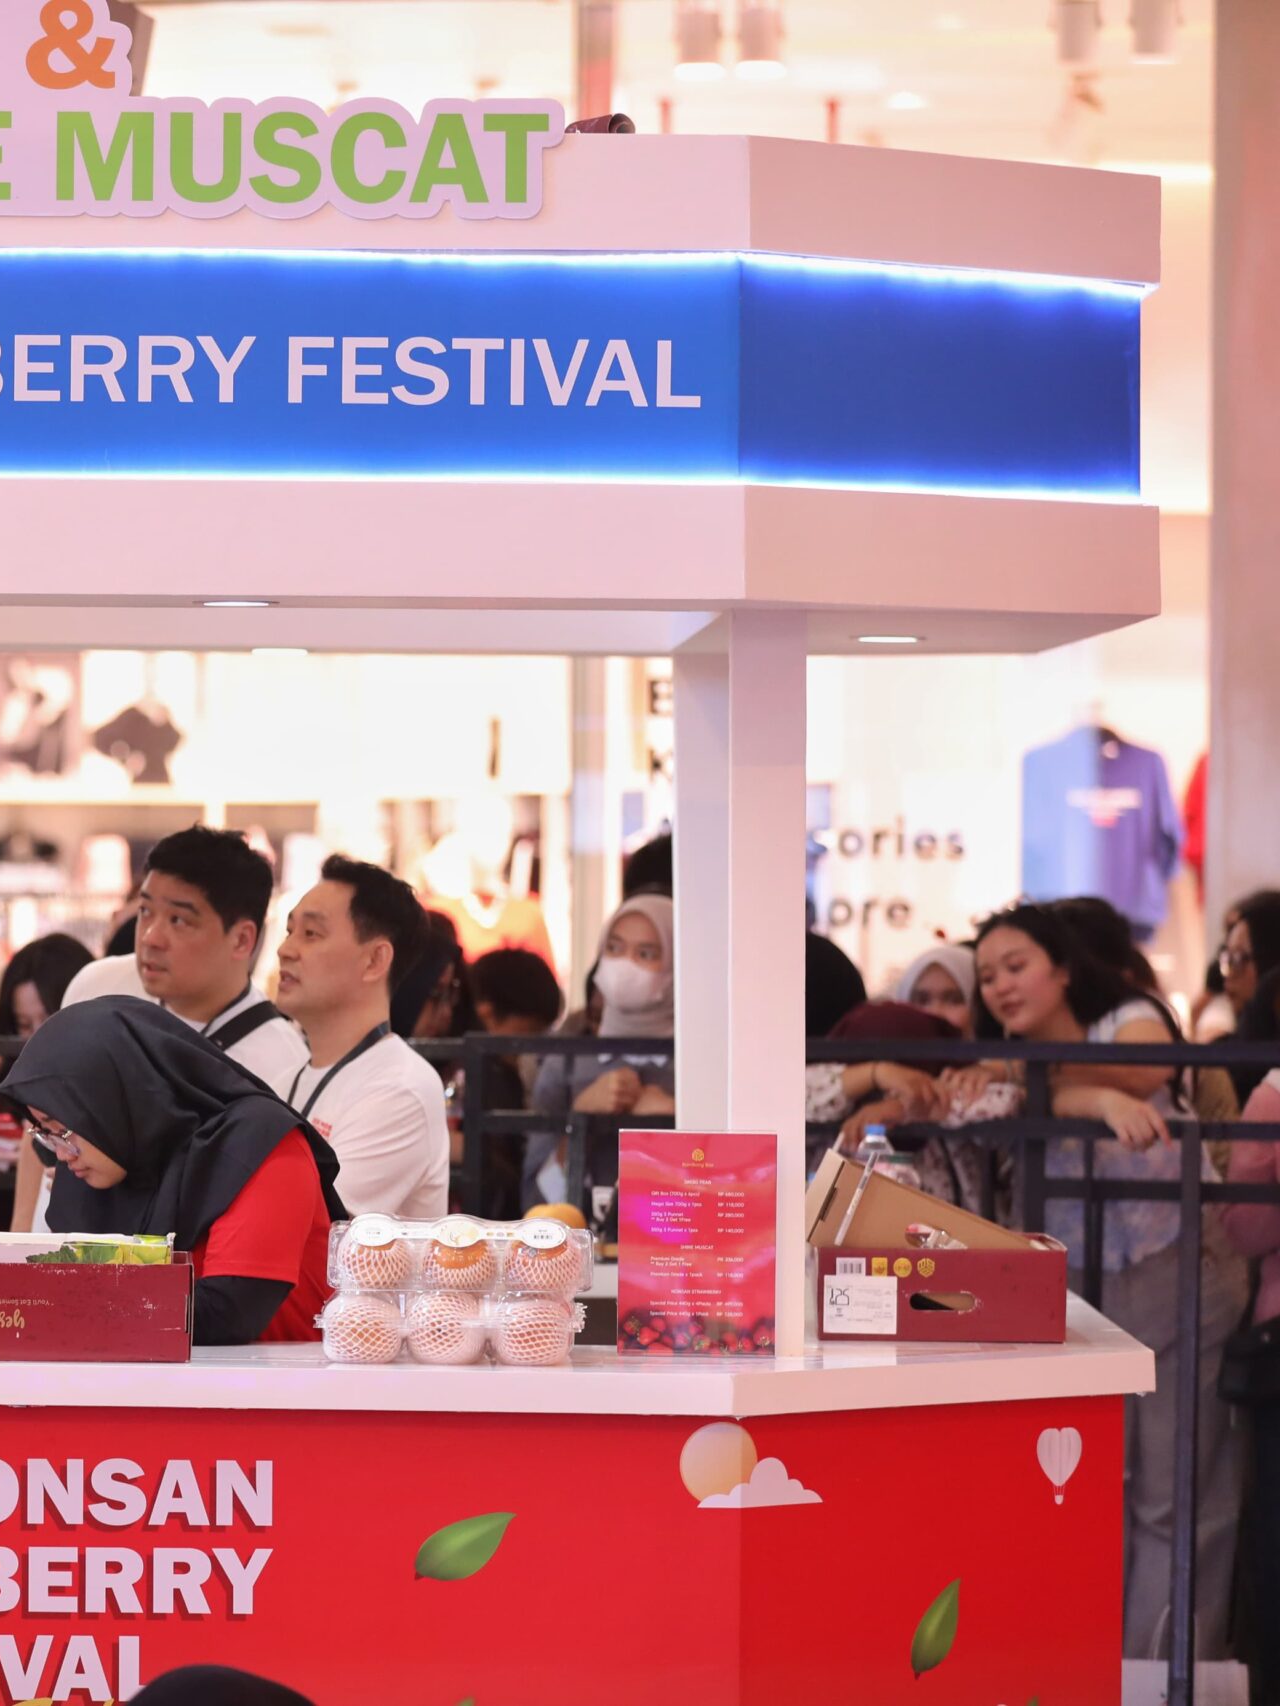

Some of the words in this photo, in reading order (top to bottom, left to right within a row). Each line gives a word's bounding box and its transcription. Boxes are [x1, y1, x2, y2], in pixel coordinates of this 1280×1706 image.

[26, 0, 116, 89] &
[57, 111, 550, 204] MUSCAT
[287, 336, 701, 408] FESTIVAL
[837, 815, 965, 861] ories
[828, 898, 911, 930] ore
